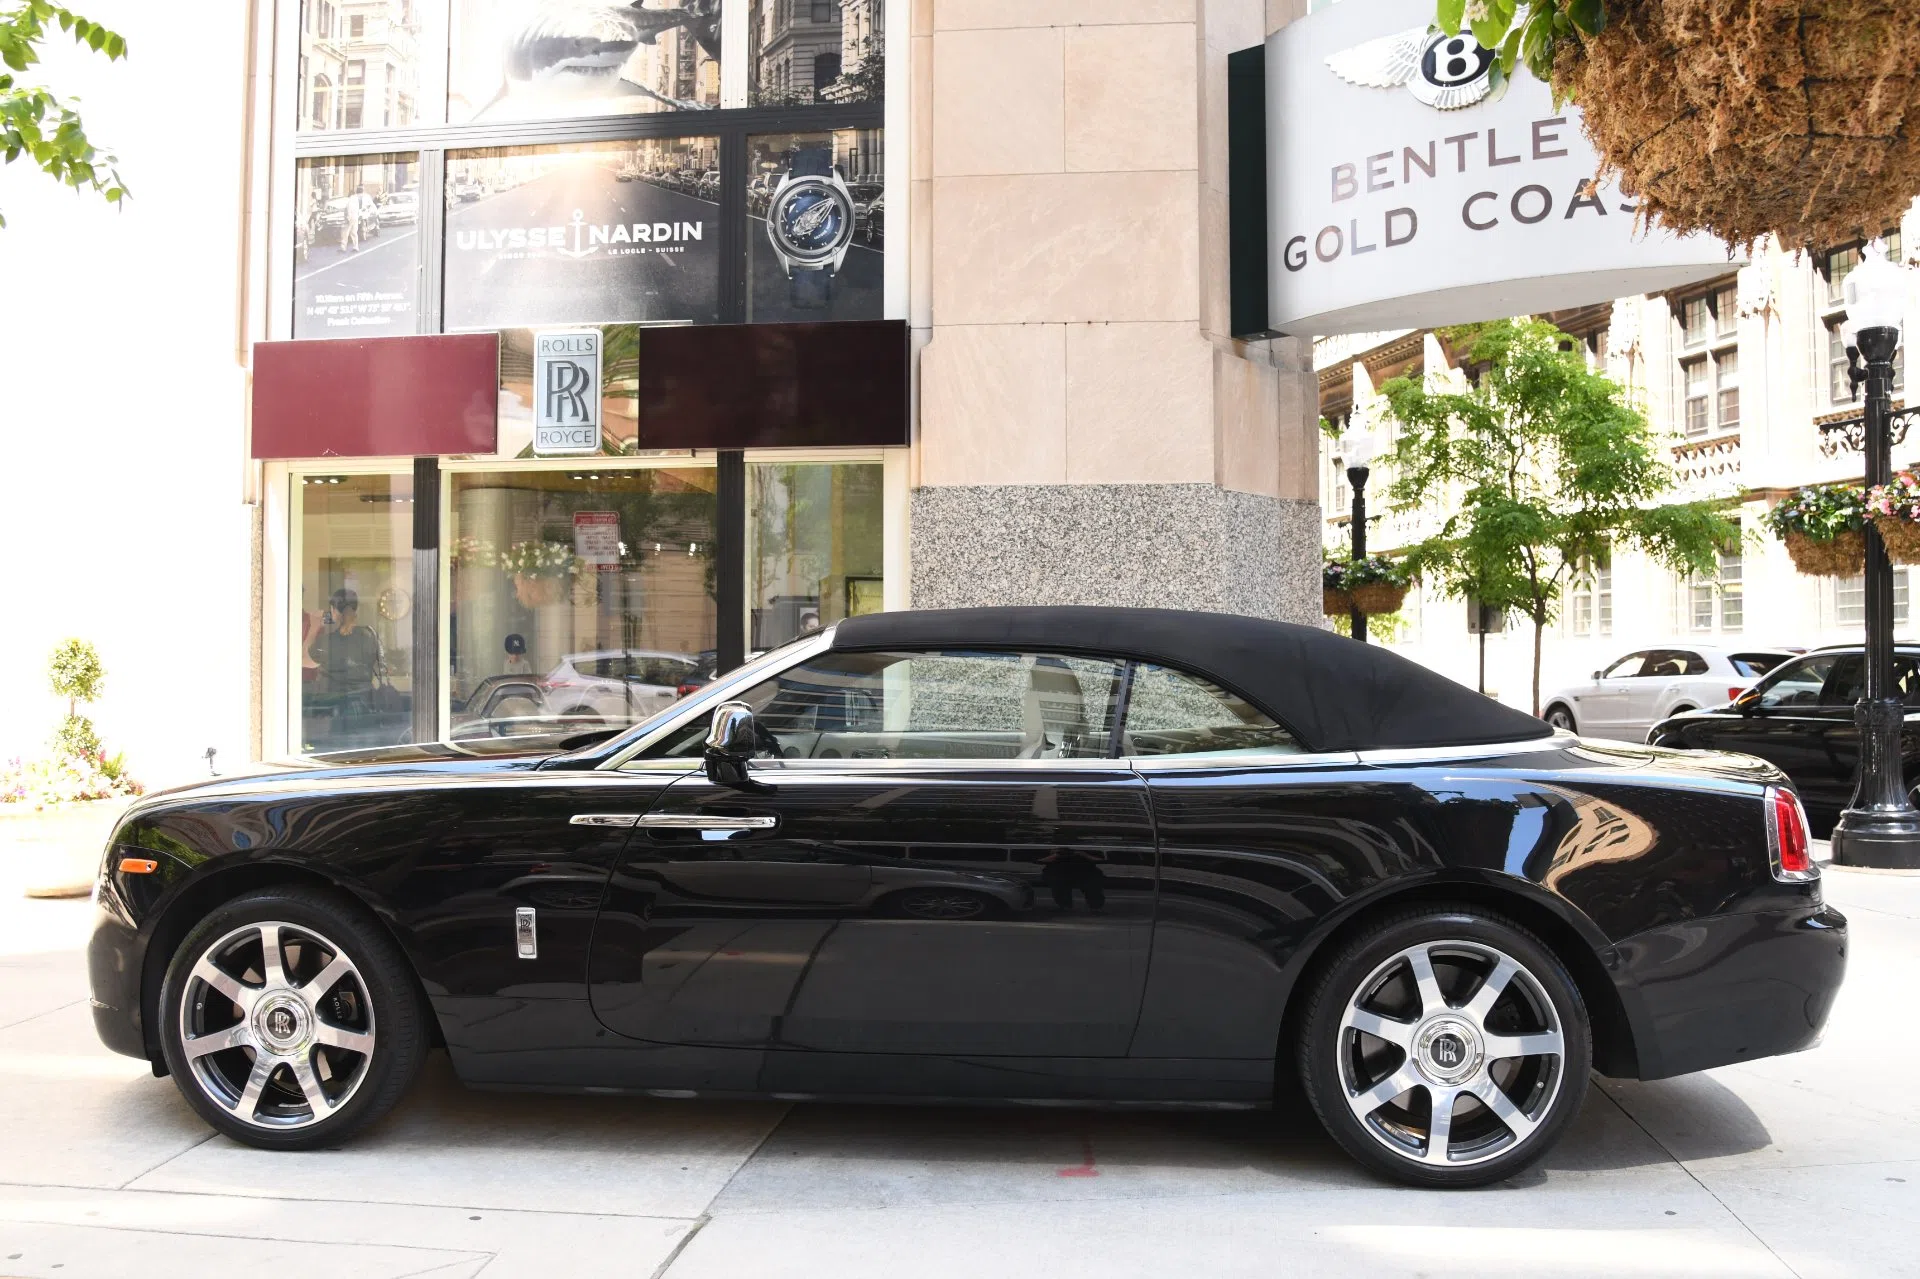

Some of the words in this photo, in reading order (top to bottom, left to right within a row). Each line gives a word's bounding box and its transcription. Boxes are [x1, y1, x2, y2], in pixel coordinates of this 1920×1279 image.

[1433, 33, 1481, 82] B
[1331, 116, 1588, 204] BENTLE
[456, 226, 566, 251] ULYSSE
[588, 221, 703, 245] NARDIN
[620, 247, 646, 255] LOCLE
[1283, 206, 1418, 272] GOLD
[542, 338, 593, 352] ROLLS
[540, 430, 592, 444] ROYCE
